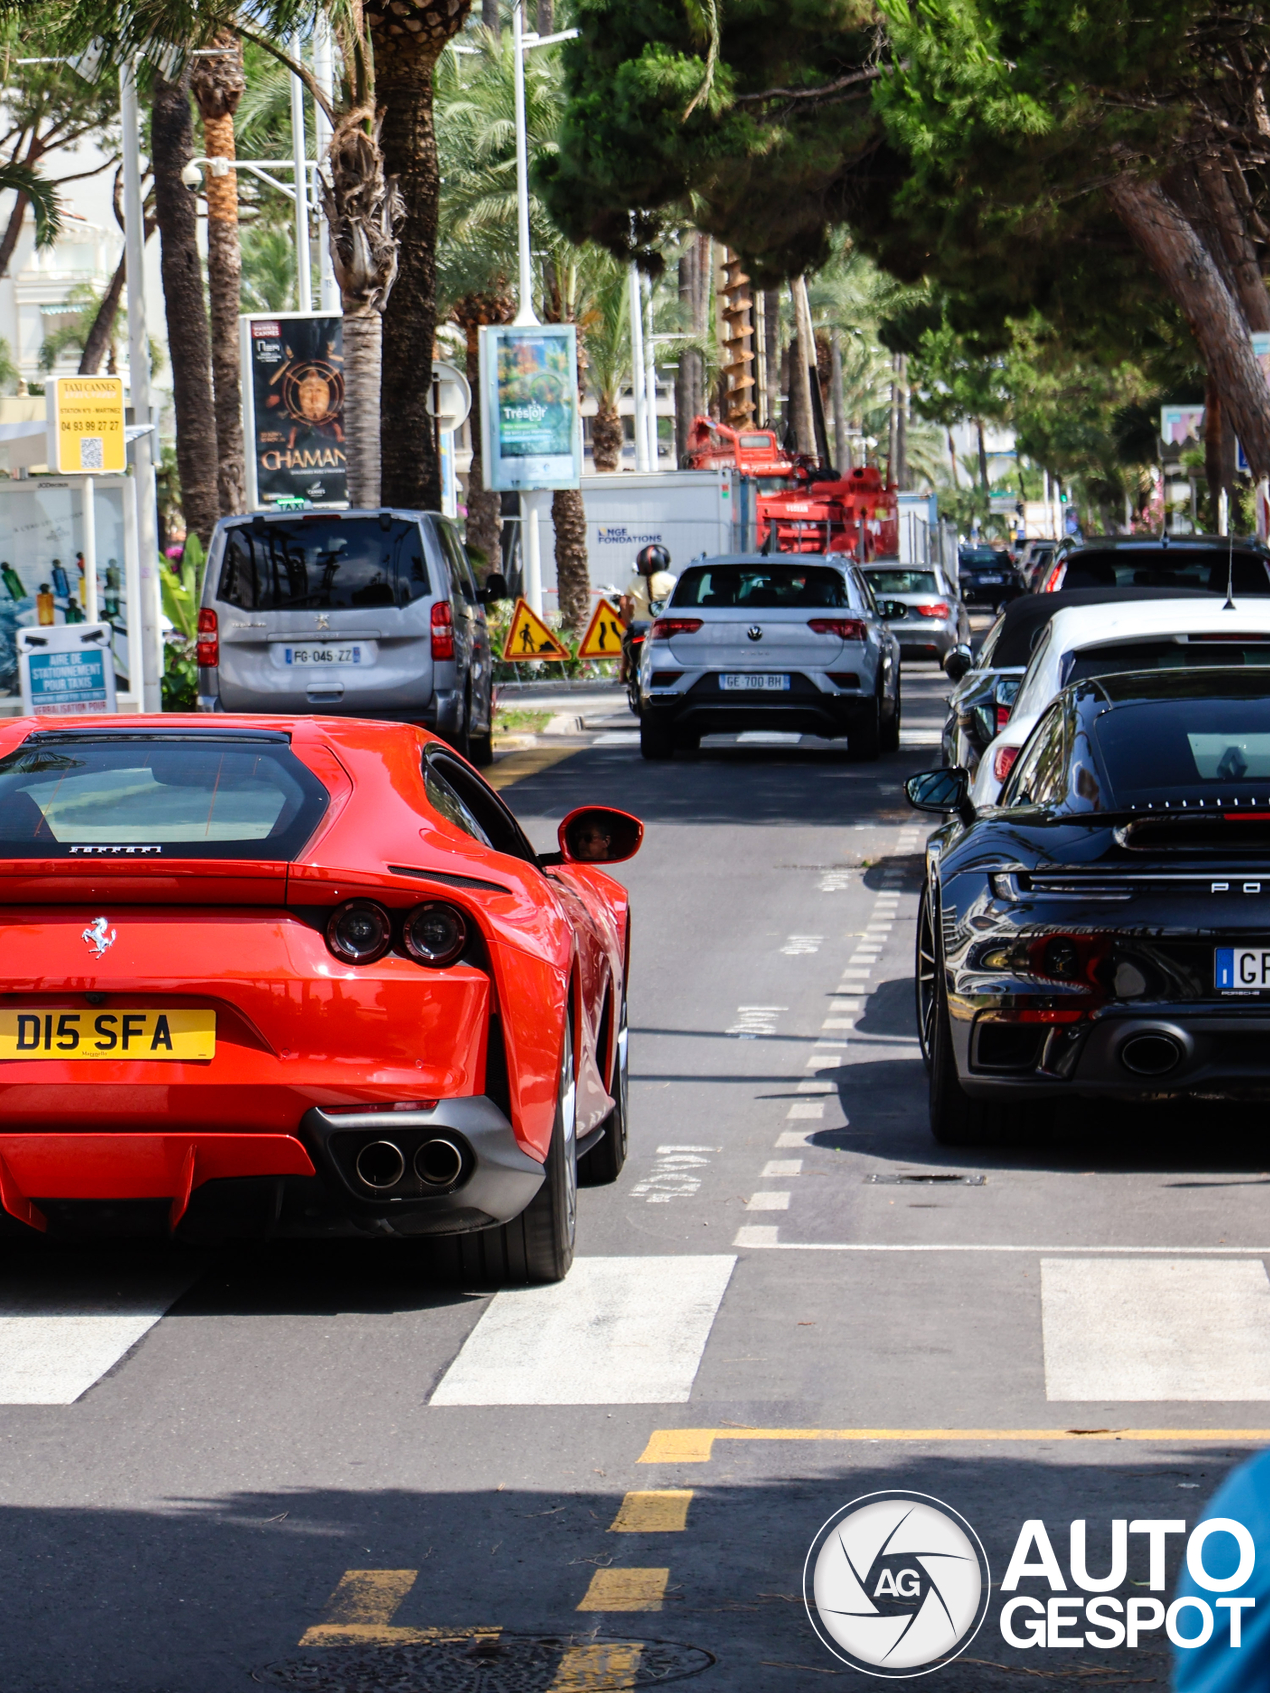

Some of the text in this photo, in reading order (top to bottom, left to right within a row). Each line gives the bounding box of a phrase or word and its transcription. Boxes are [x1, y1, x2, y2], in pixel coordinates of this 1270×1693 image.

[64, 383, 117, 392] TAXI CANNES
[61, 421, 119, 431] 04 93 99 27 27
[280, 503, 304, 511] TAXI
[607, 528, 628, 537] NGE
[598, 535, 662, 544] FONDATIONS
[49, 652, 83, 666] AIRE DE
[32, 664, 101, 680] STATIONNEMENT
[44, 677, 92, 691] POUR TAXIS
[34, 701, 106, 715] VERBALISATION POUR
[94, 1014, 173, 1051] SFA
